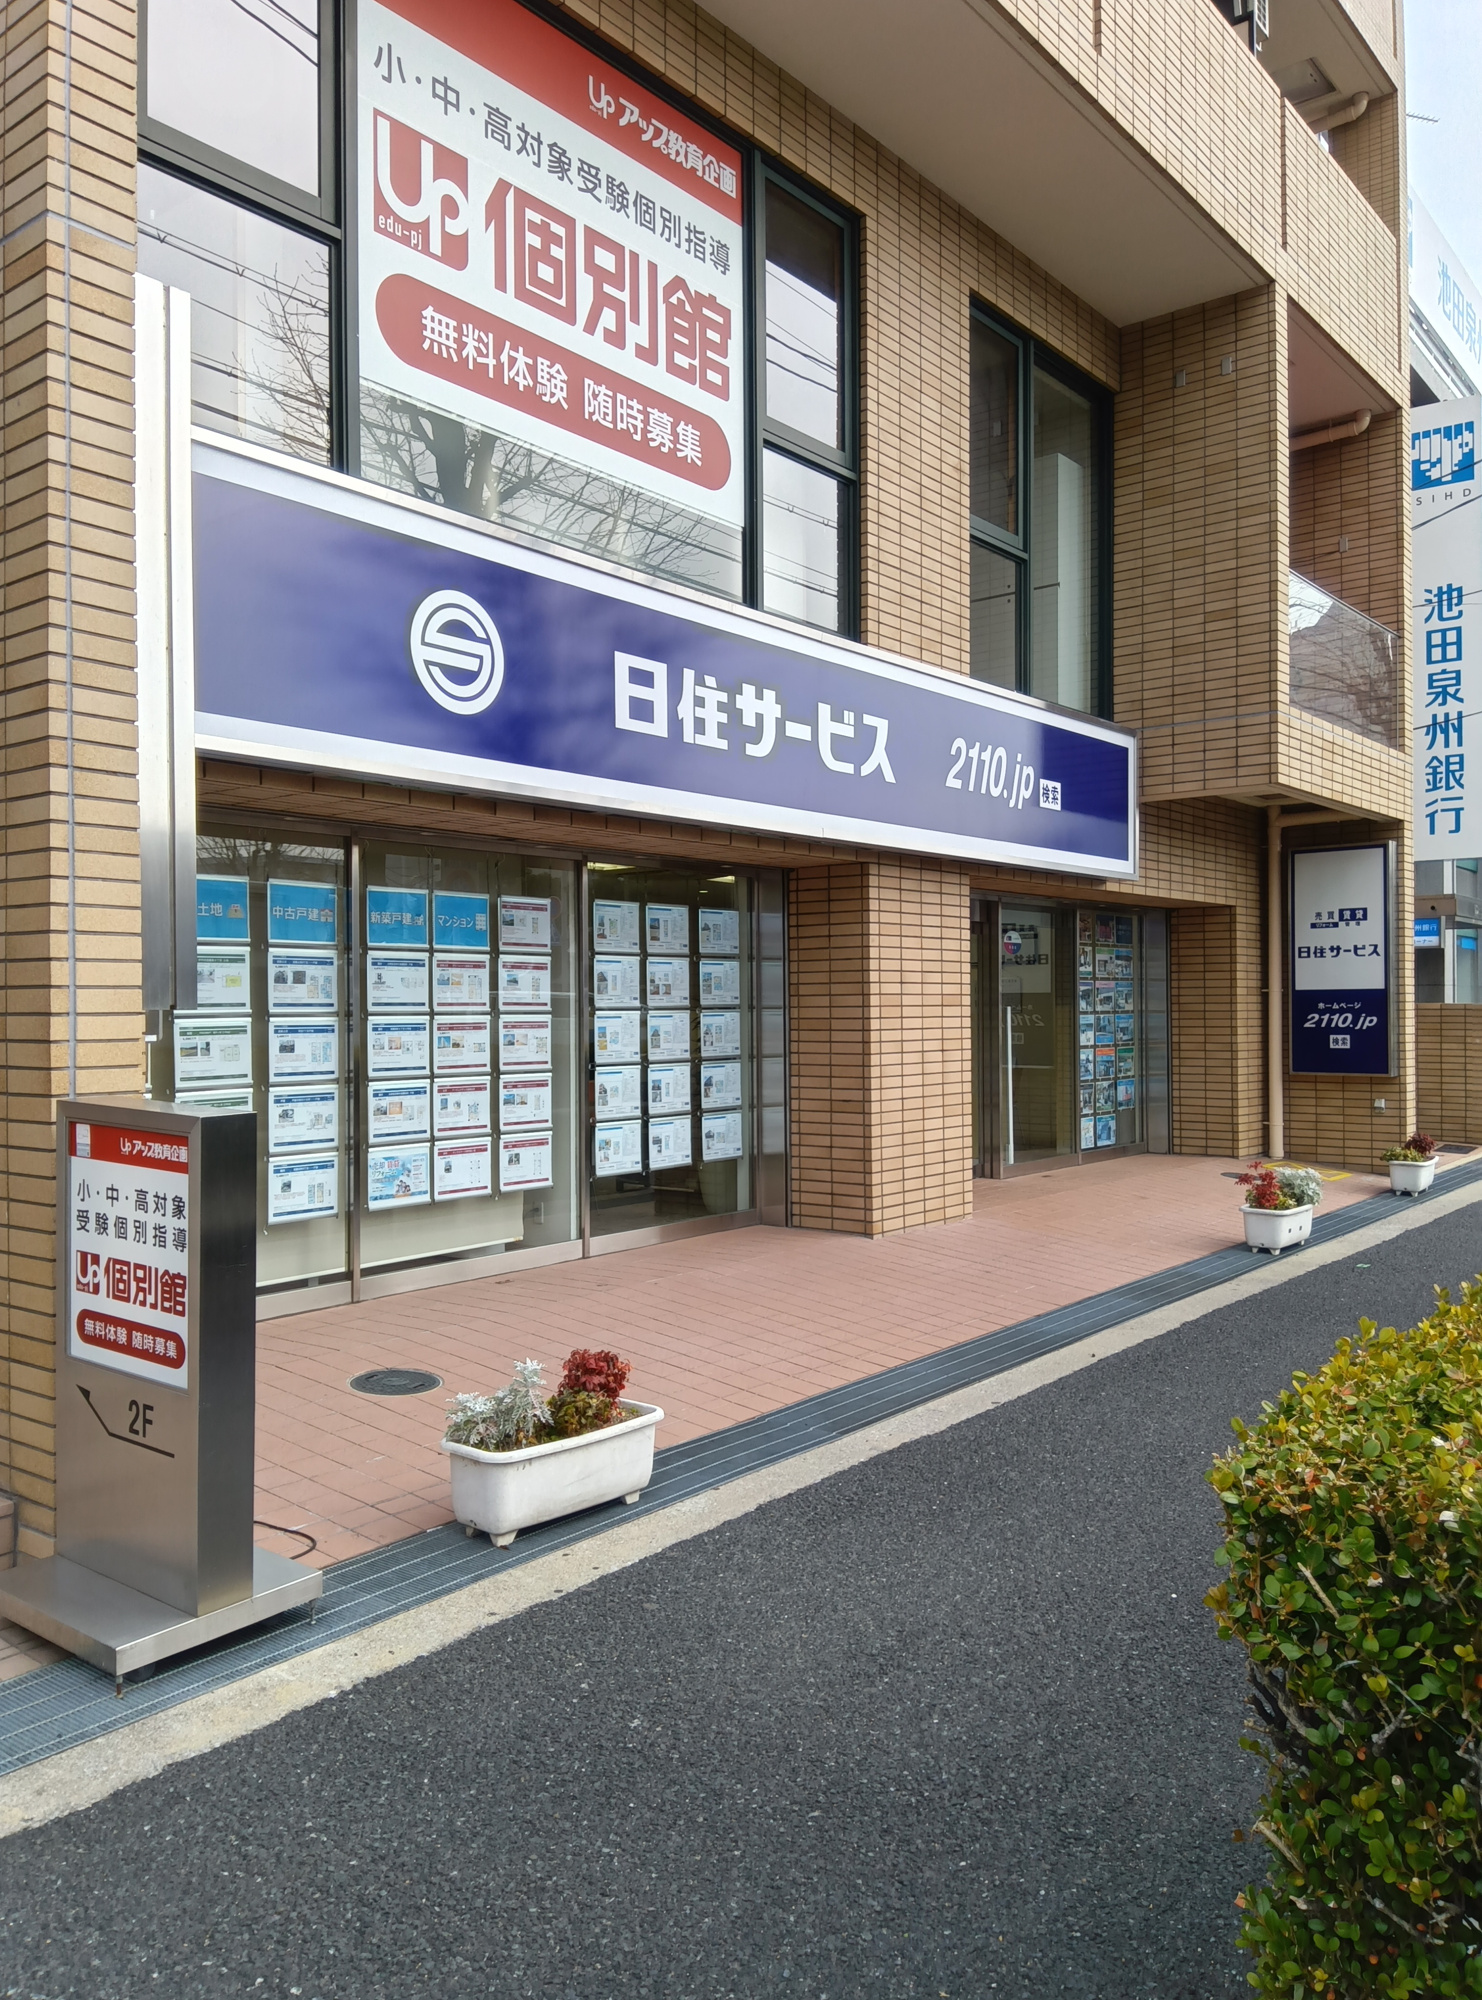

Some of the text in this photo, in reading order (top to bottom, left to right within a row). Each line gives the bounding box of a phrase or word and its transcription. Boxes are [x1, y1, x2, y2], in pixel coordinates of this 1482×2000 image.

[618, 97, 736, 199] アップ教育企画
[378, 214, 422, 250] edu-pj
[485, 177, 732, 402] 個別館
[420, 305, 703, 467] 無料体験 随時募集
[1424, 583, 1465, 836] 池田泉州銀行
[614, 650, 1059, 810] 日住サービス 2110.jp 検索
[197, 902, 223, 917] 土地
[272, 906, 319, 922] 中古戸建
[370, 911, 412, 926] 新築戸建
[437, 915, 474, 929] マンション
[1297, 944, 1381, 959] 日住サービス
[1303, 1012, 1378, 1030] 2110.jp
[1317, 1002, 1361, 1010] ホームページ
[1331, 1036, 1349, 1047] 検索
[132, 1139, 188, 1163] アップ教育企画
[76, 1208, 187, 1253] 受験個別指導
[104, 1256, 187, 1318] 個別館
[84, 1317, 178, 1359] 無料体験 随時募集
[128, 1399, 154, 1439] 2F
